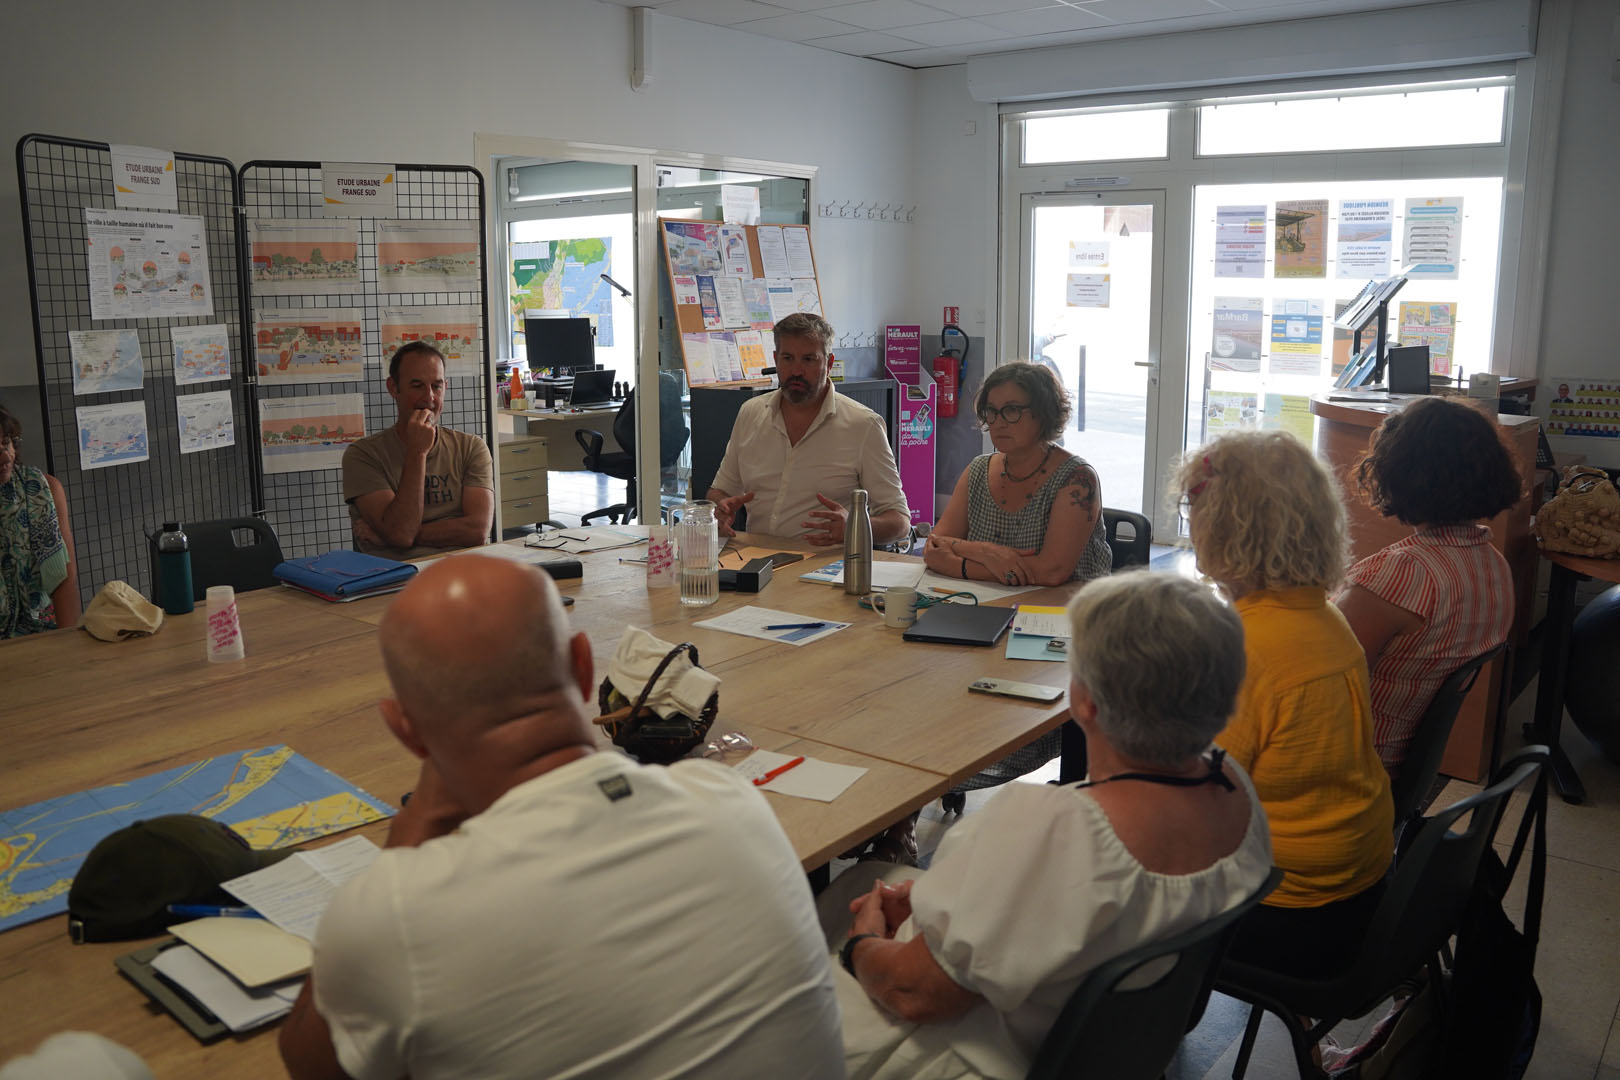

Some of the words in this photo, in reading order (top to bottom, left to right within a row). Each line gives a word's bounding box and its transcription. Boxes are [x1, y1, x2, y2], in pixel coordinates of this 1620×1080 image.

[125, 163, 142, 172] ETUDE
[142, 165, 163, 174] URBAINE
[130, 175, 150, 184] FRANGE
[150, 176, 160, 185] SUD
